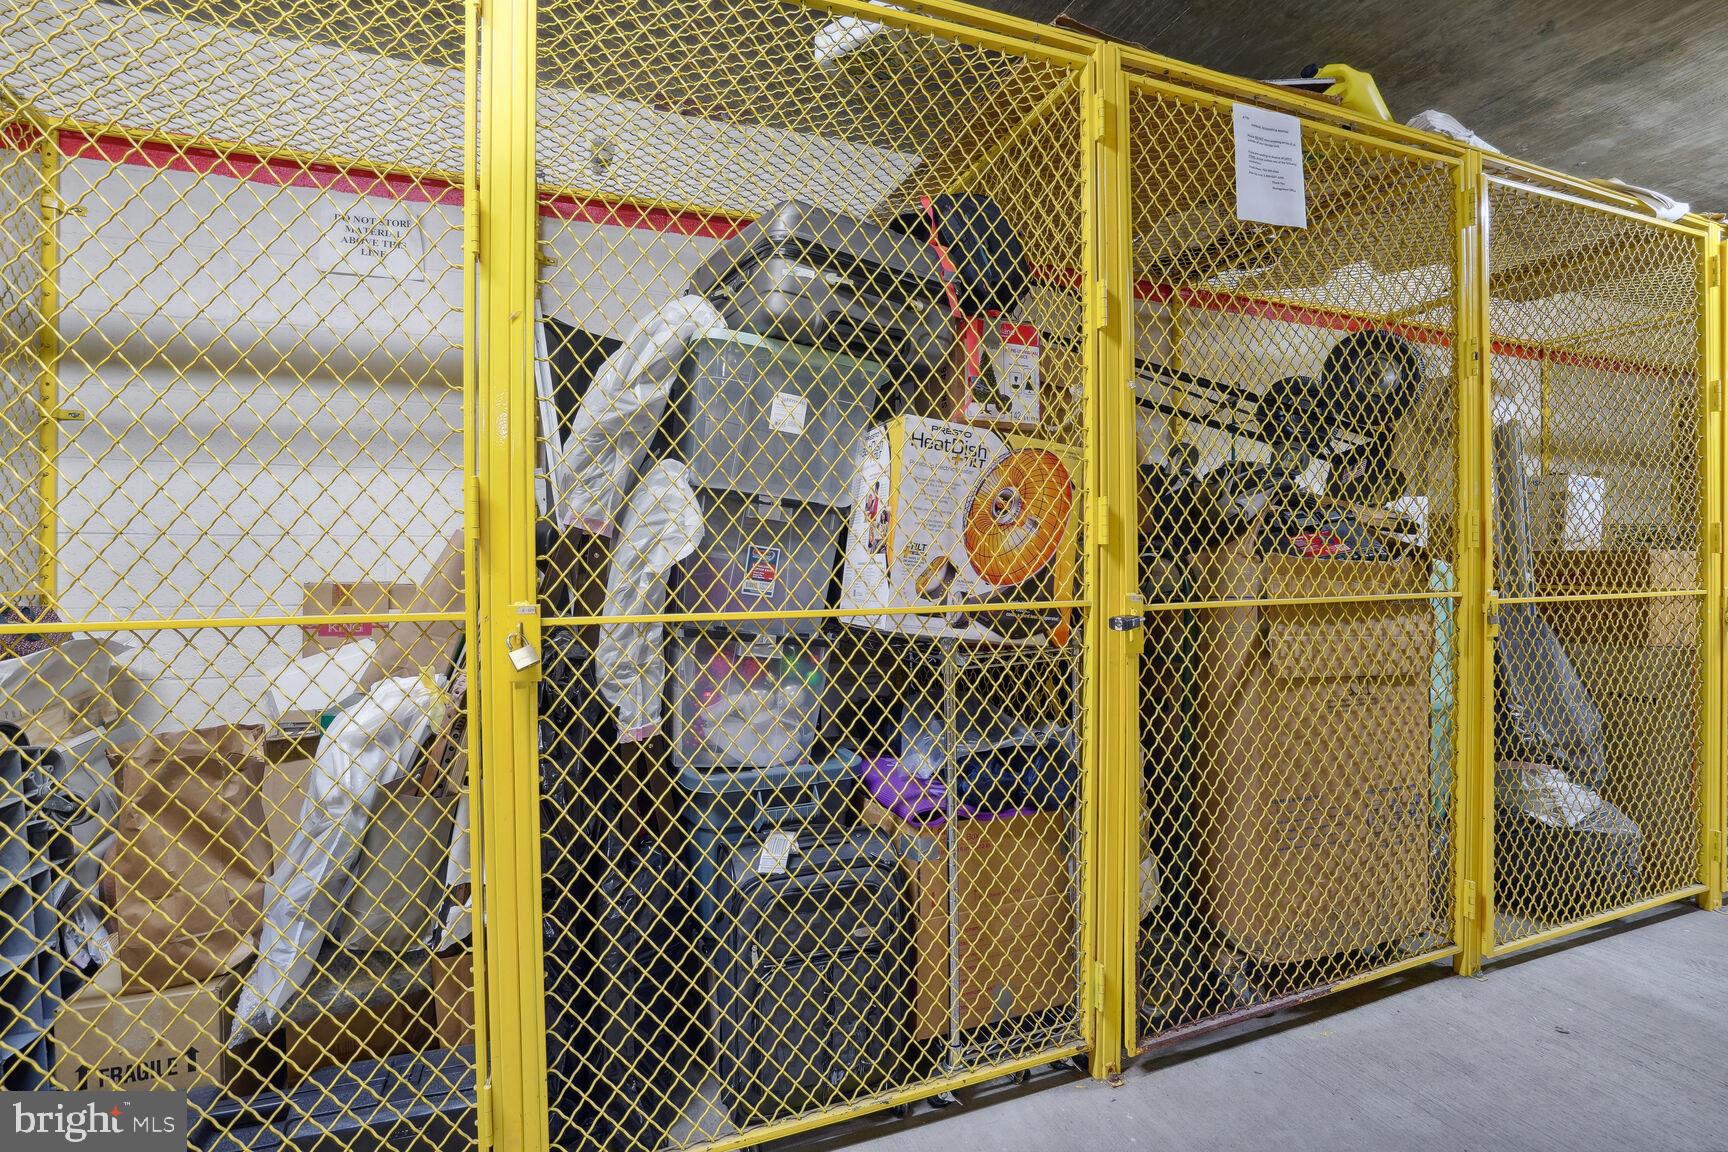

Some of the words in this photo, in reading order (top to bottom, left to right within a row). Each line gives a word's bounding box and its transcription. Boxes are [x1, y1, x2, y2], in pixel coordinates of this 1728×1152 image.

[353, 215, 377, 225] NOT
[931, 425, 973, 439] PRESTO
[911, 432, 987, 459] HeatDish
[98, 1057, 179, 1088] FRAGILE
